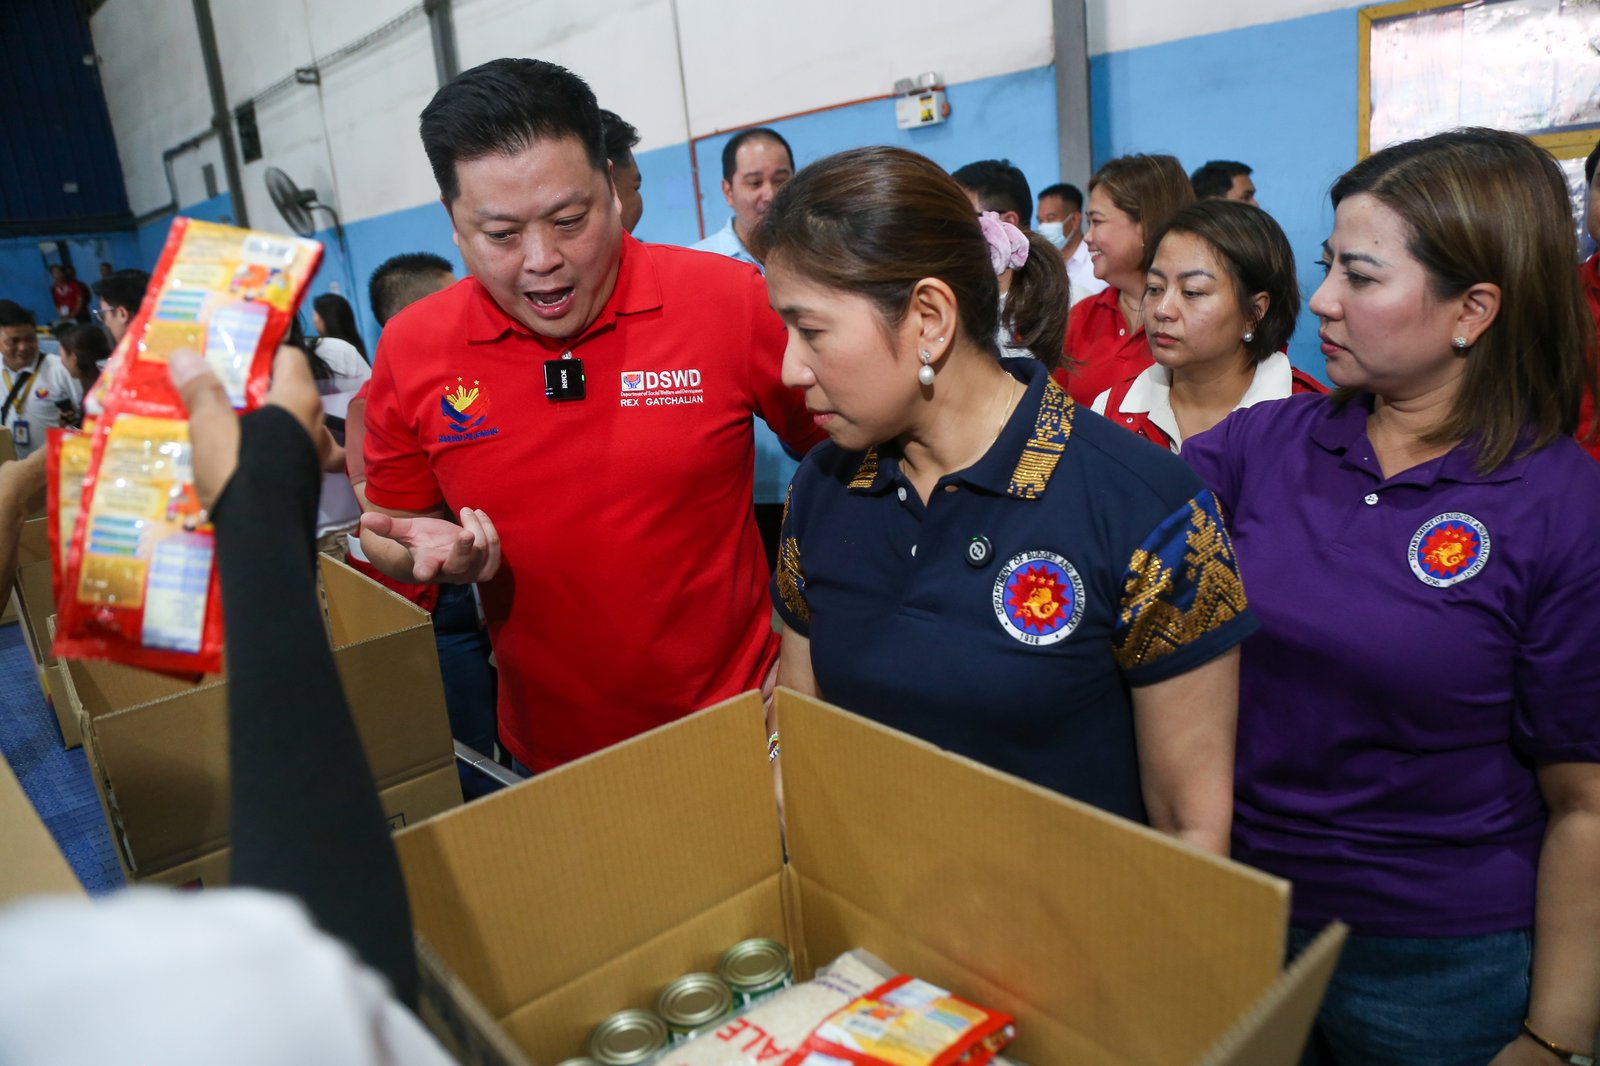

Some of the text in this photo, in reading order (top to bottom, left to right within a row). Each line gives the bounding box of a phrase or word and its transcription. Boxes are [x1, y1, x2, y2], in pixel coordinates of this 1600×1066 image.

[646, 369, 702, 389] DSWD
[620, 395, 704, 407] REX GATCHALIAN
